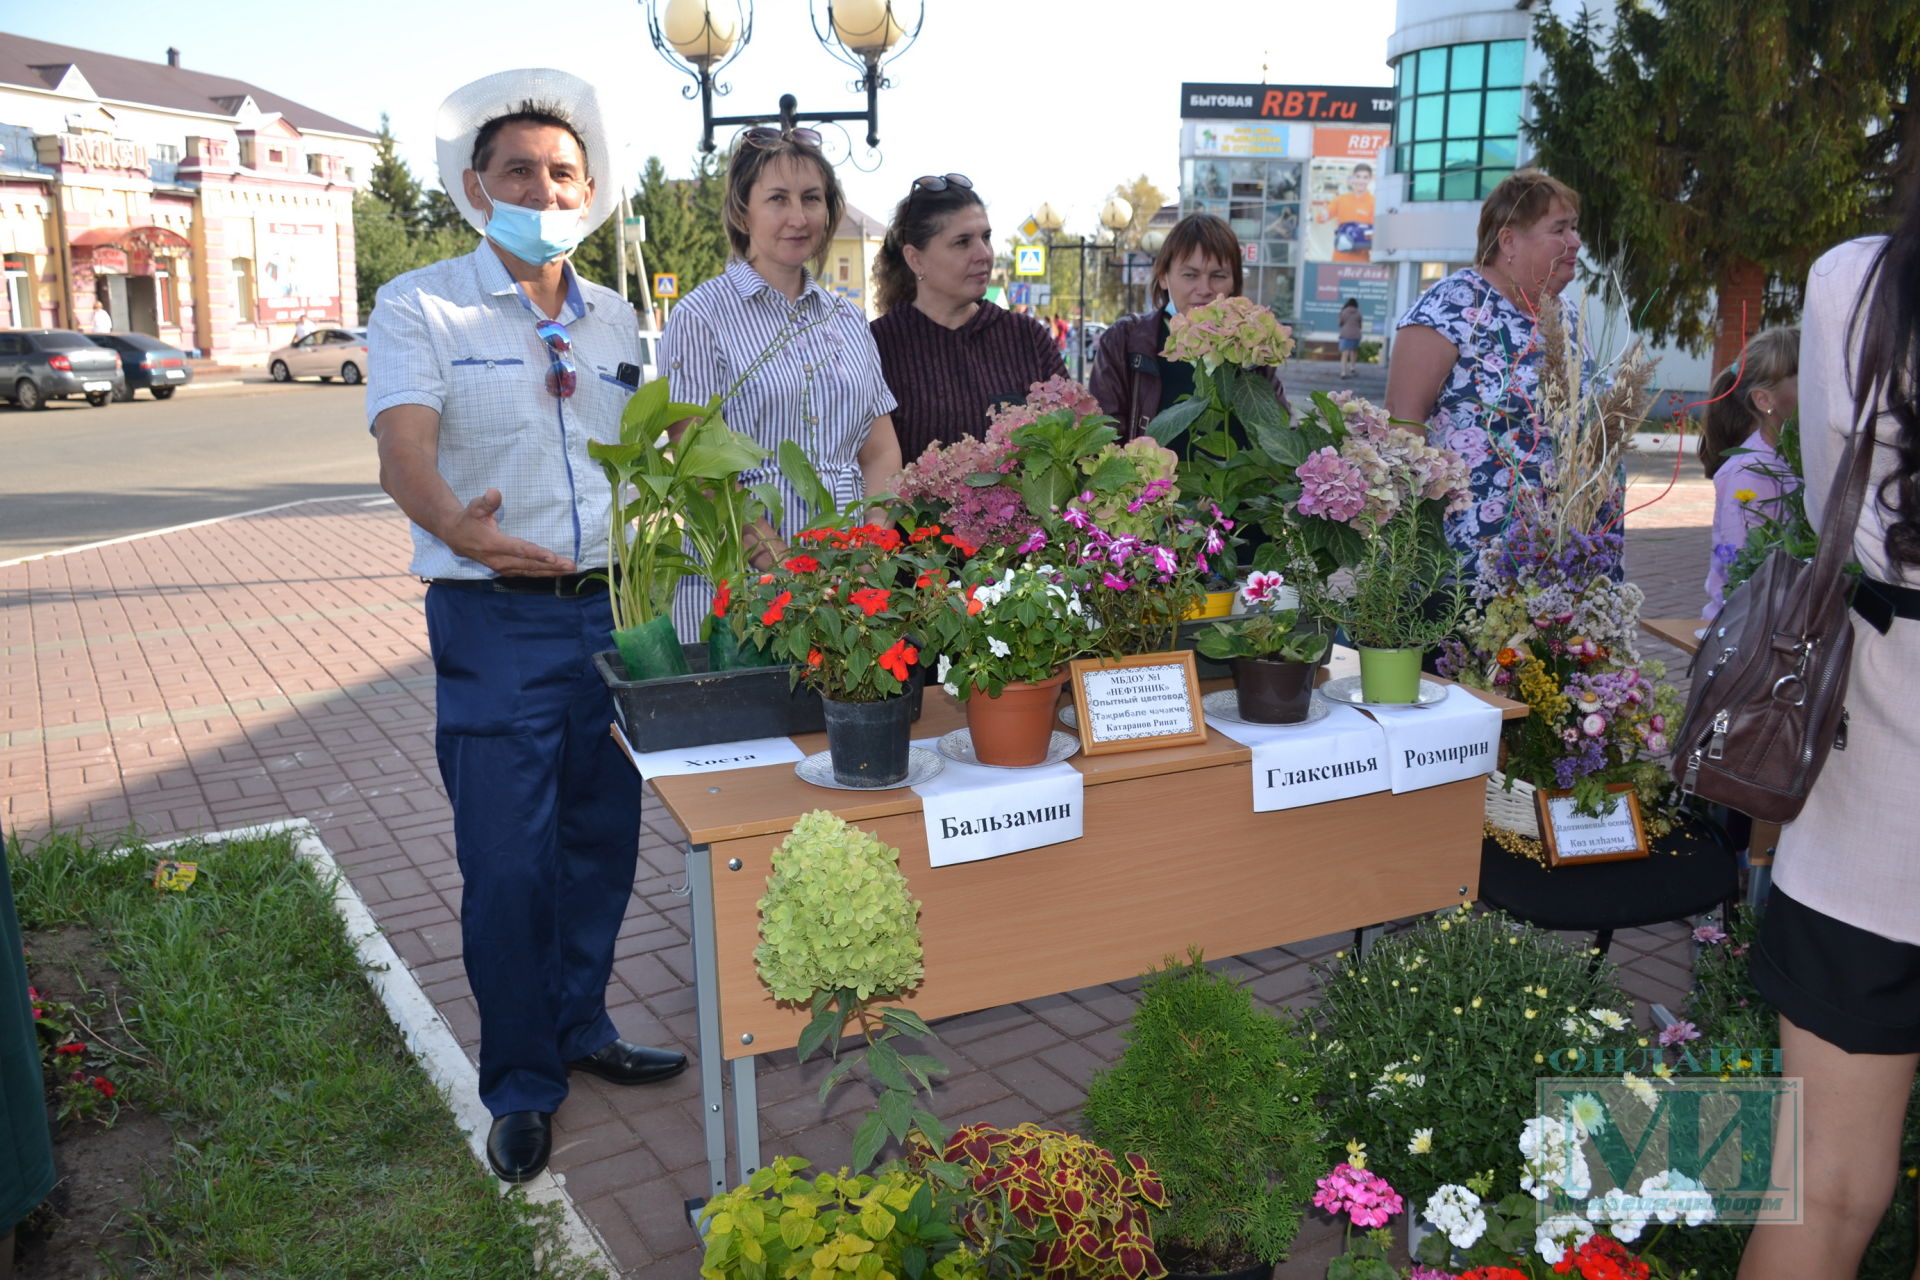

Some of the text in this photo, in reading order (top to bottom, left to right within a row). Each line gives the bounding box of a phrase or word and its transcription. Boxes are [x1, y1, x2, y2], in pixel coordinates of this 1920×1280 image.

[1190, 94, 1253, 108] БЫТОВАЯ
[1261, 90, 1358, 119] RBT.ru
[1111, 675, 1145, 685] МБДОУ
[1092, 693, 1184, 707] Опытный цветовод
[1153, 719, 1178, 727] Ринат
[684, 754, 756, 767] Хоста
[1404, 741, 1489, 768] Розмирин
[1266, 757, 1378, 788] Глаксинья
[940, 803, 1071, 839] Бальзамин
